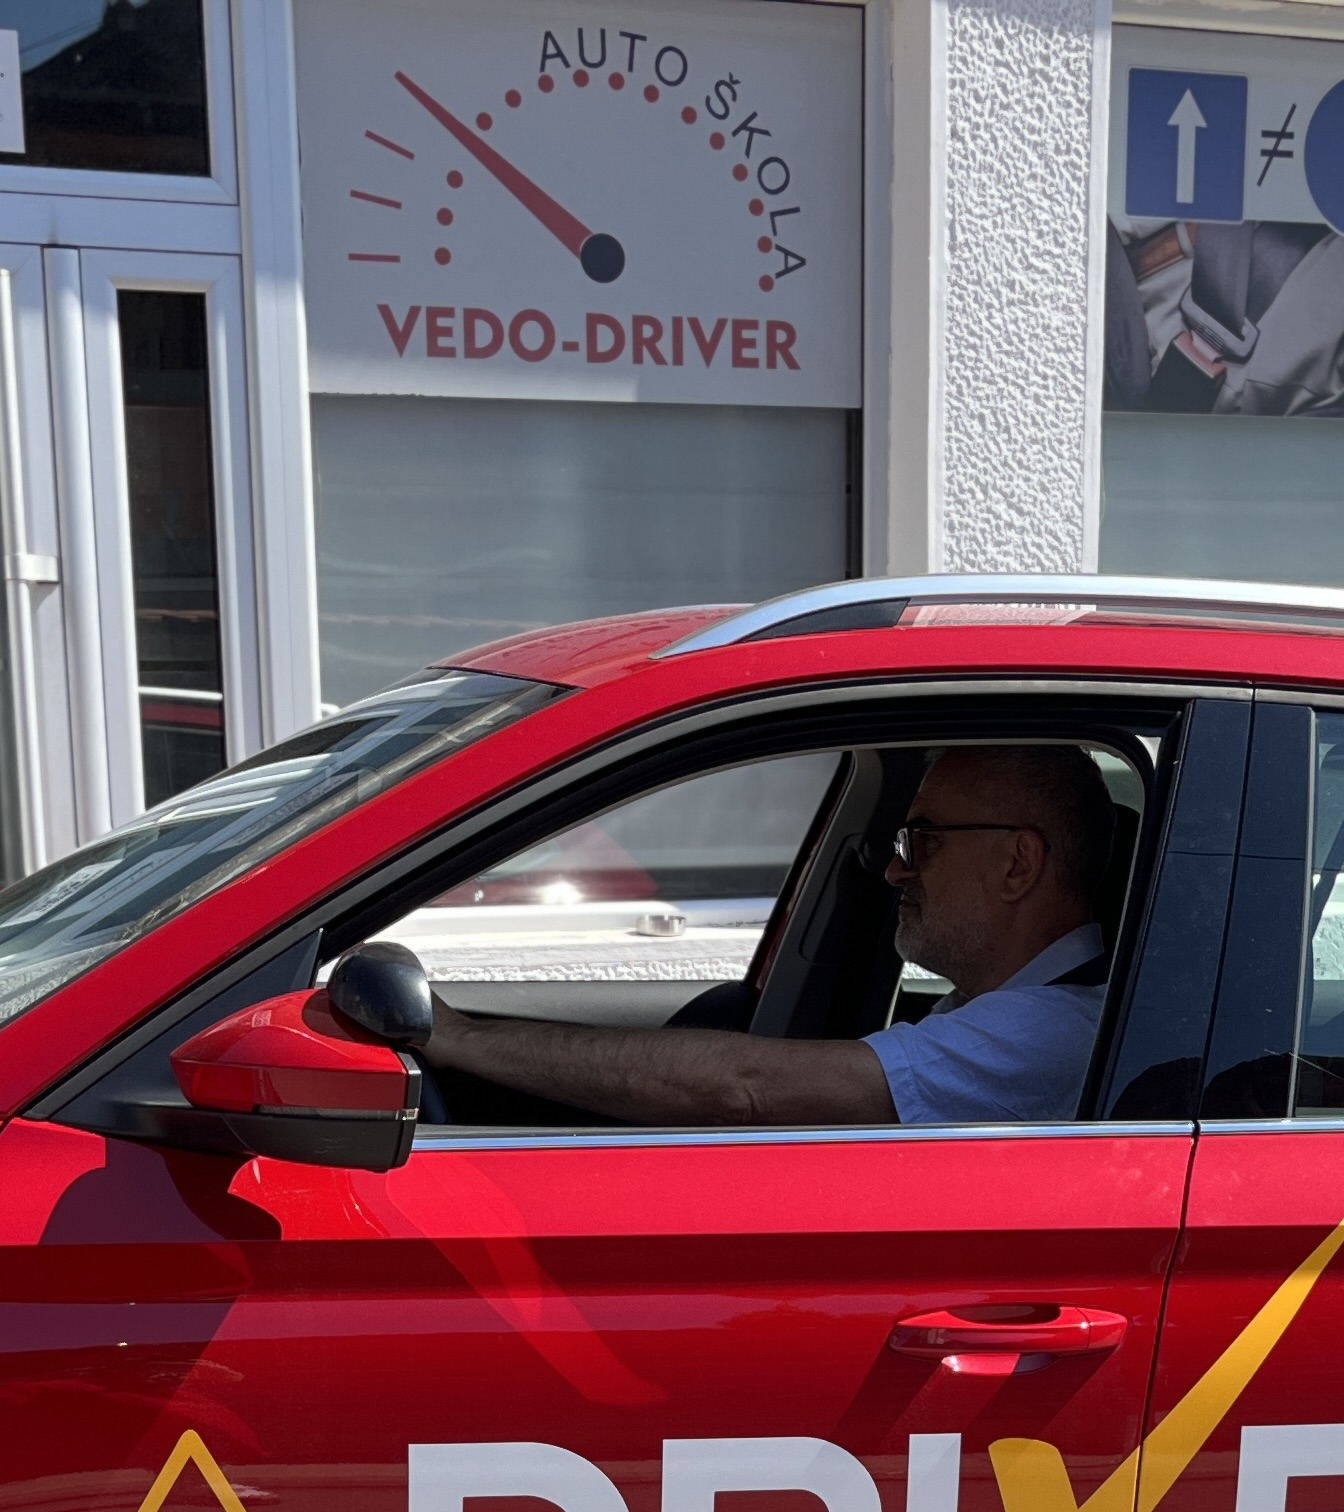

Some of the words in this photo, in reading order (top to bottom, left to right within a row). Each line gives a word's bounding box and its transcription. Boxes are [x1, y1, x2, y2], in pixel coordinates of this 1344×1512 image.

[539, 27, 688, 87] AUTO
[705, 72, 806, 279] ŠKOLA
[376, 303, 801, 370] VEDO-DRIVER
